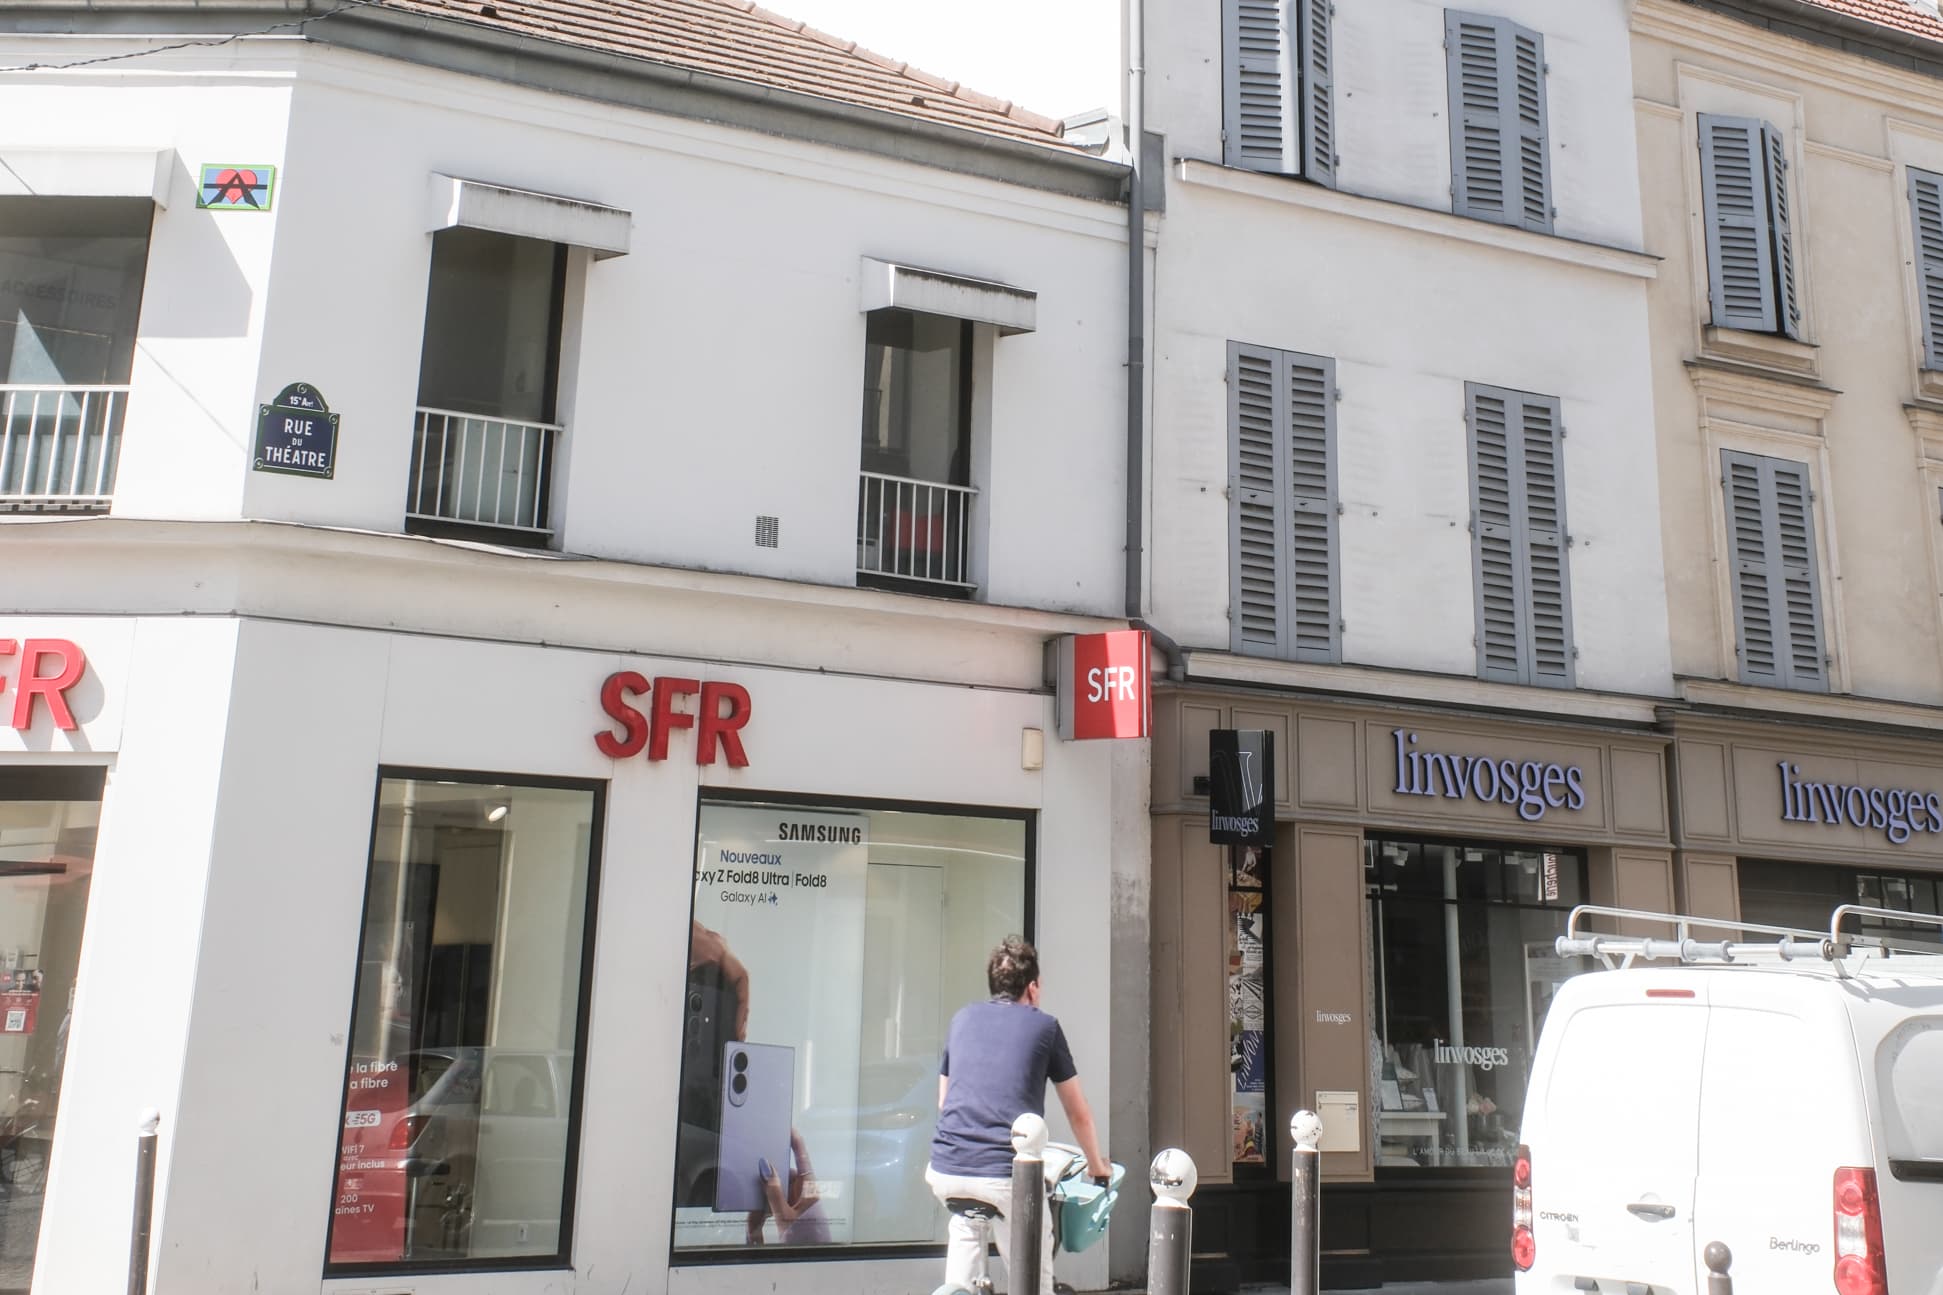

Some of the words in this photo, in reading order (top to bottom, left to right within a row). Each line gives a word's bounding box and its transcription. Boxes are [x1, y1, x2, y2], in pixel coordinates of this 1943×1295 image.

[284, 418, 313, 436] RUE
[291, 438, 303, 446] DU
[265, 445, 326, 467] THÉATRE
[1087, 666, 1136, 703] SFR
[594, 671, 751, 767] SFR
[1391, 728, 1585, 822] linvosges
[1777, 761, 1943, 844] linvosges
[1211, 809, 1259, 837] linvosges
[778, 822, 861, 845] SAMSUNG
[720, 849, 782, 866] Nouveaux
[717, 869, 724, 883] Z
[727, 870, 759, 884] Fold8
[761, 871, 789, 886] Ultra
[795, 873, 827, 888] Fold8
[720, 890, 756, 906] Galaxy
[1317, 1010, 1352, 1024] linvosges
[1433, 1038, 1508, 1071] linvosges
[356, 1062, 367, 1073] la
[370, 1060, 398, 1073] fibre
[360, 1077, 388, 1089] fibre
[359, 1113, 376, 1125] 5G
[357, 1159, 385, 1169] inclus
[341, 1194, 358, 1204] 200
[362, 1204, 375, 1213] TV
[1769, 1236, 1820, 1256] Berlingo
